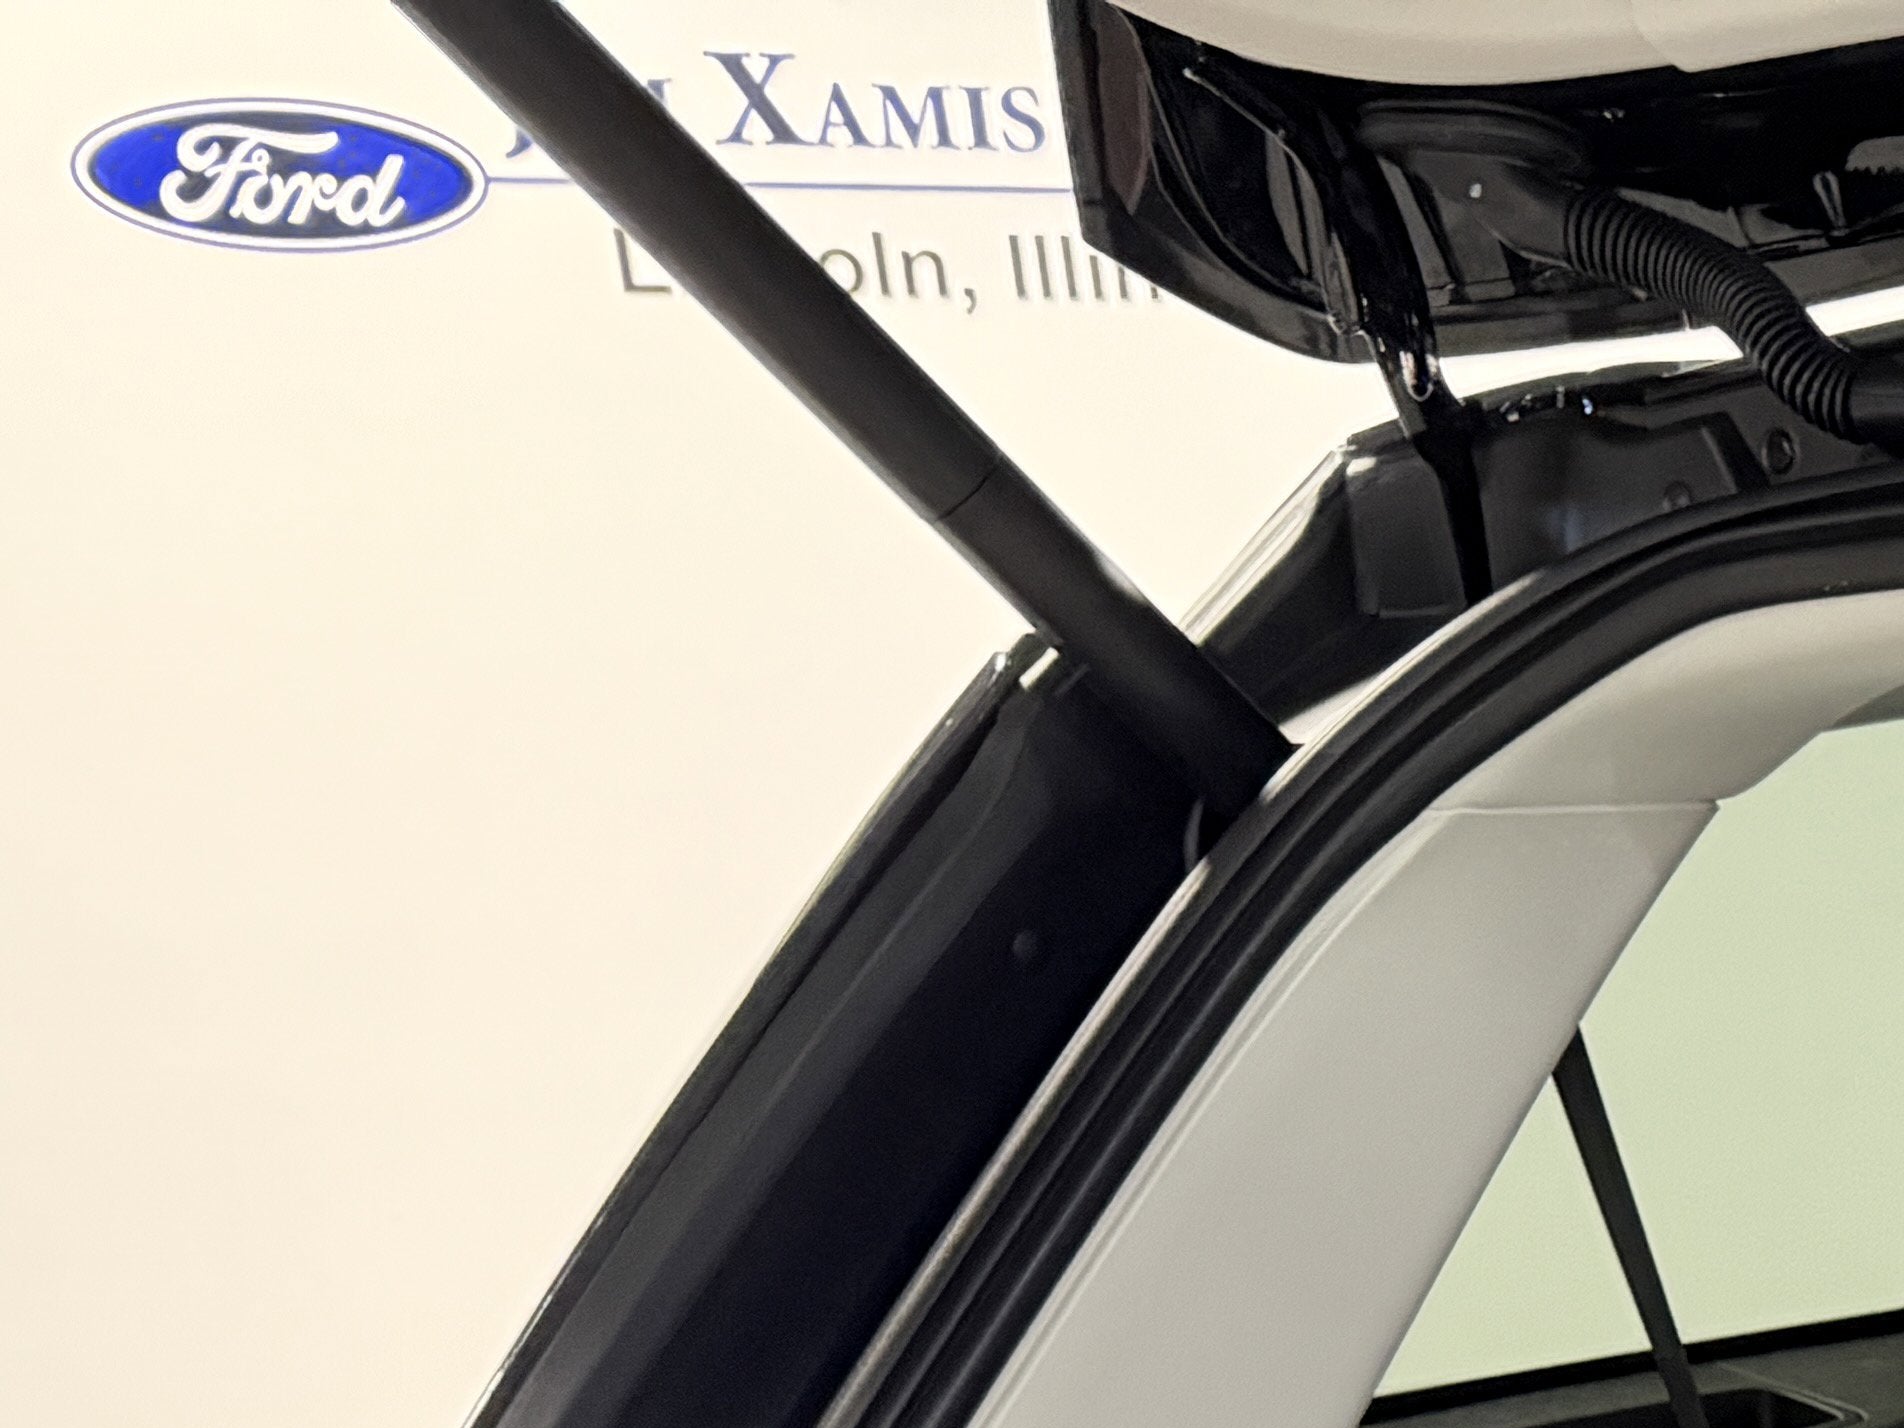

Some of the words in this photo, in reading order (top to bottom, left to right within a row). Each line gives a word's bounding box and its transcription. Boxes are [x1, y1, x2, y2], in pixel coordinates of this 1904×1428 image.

[703, 50, 1047, 154] XAMIS
[159, 122, 406, 228] Ford
[613, 228, 977, 314] Loln,
